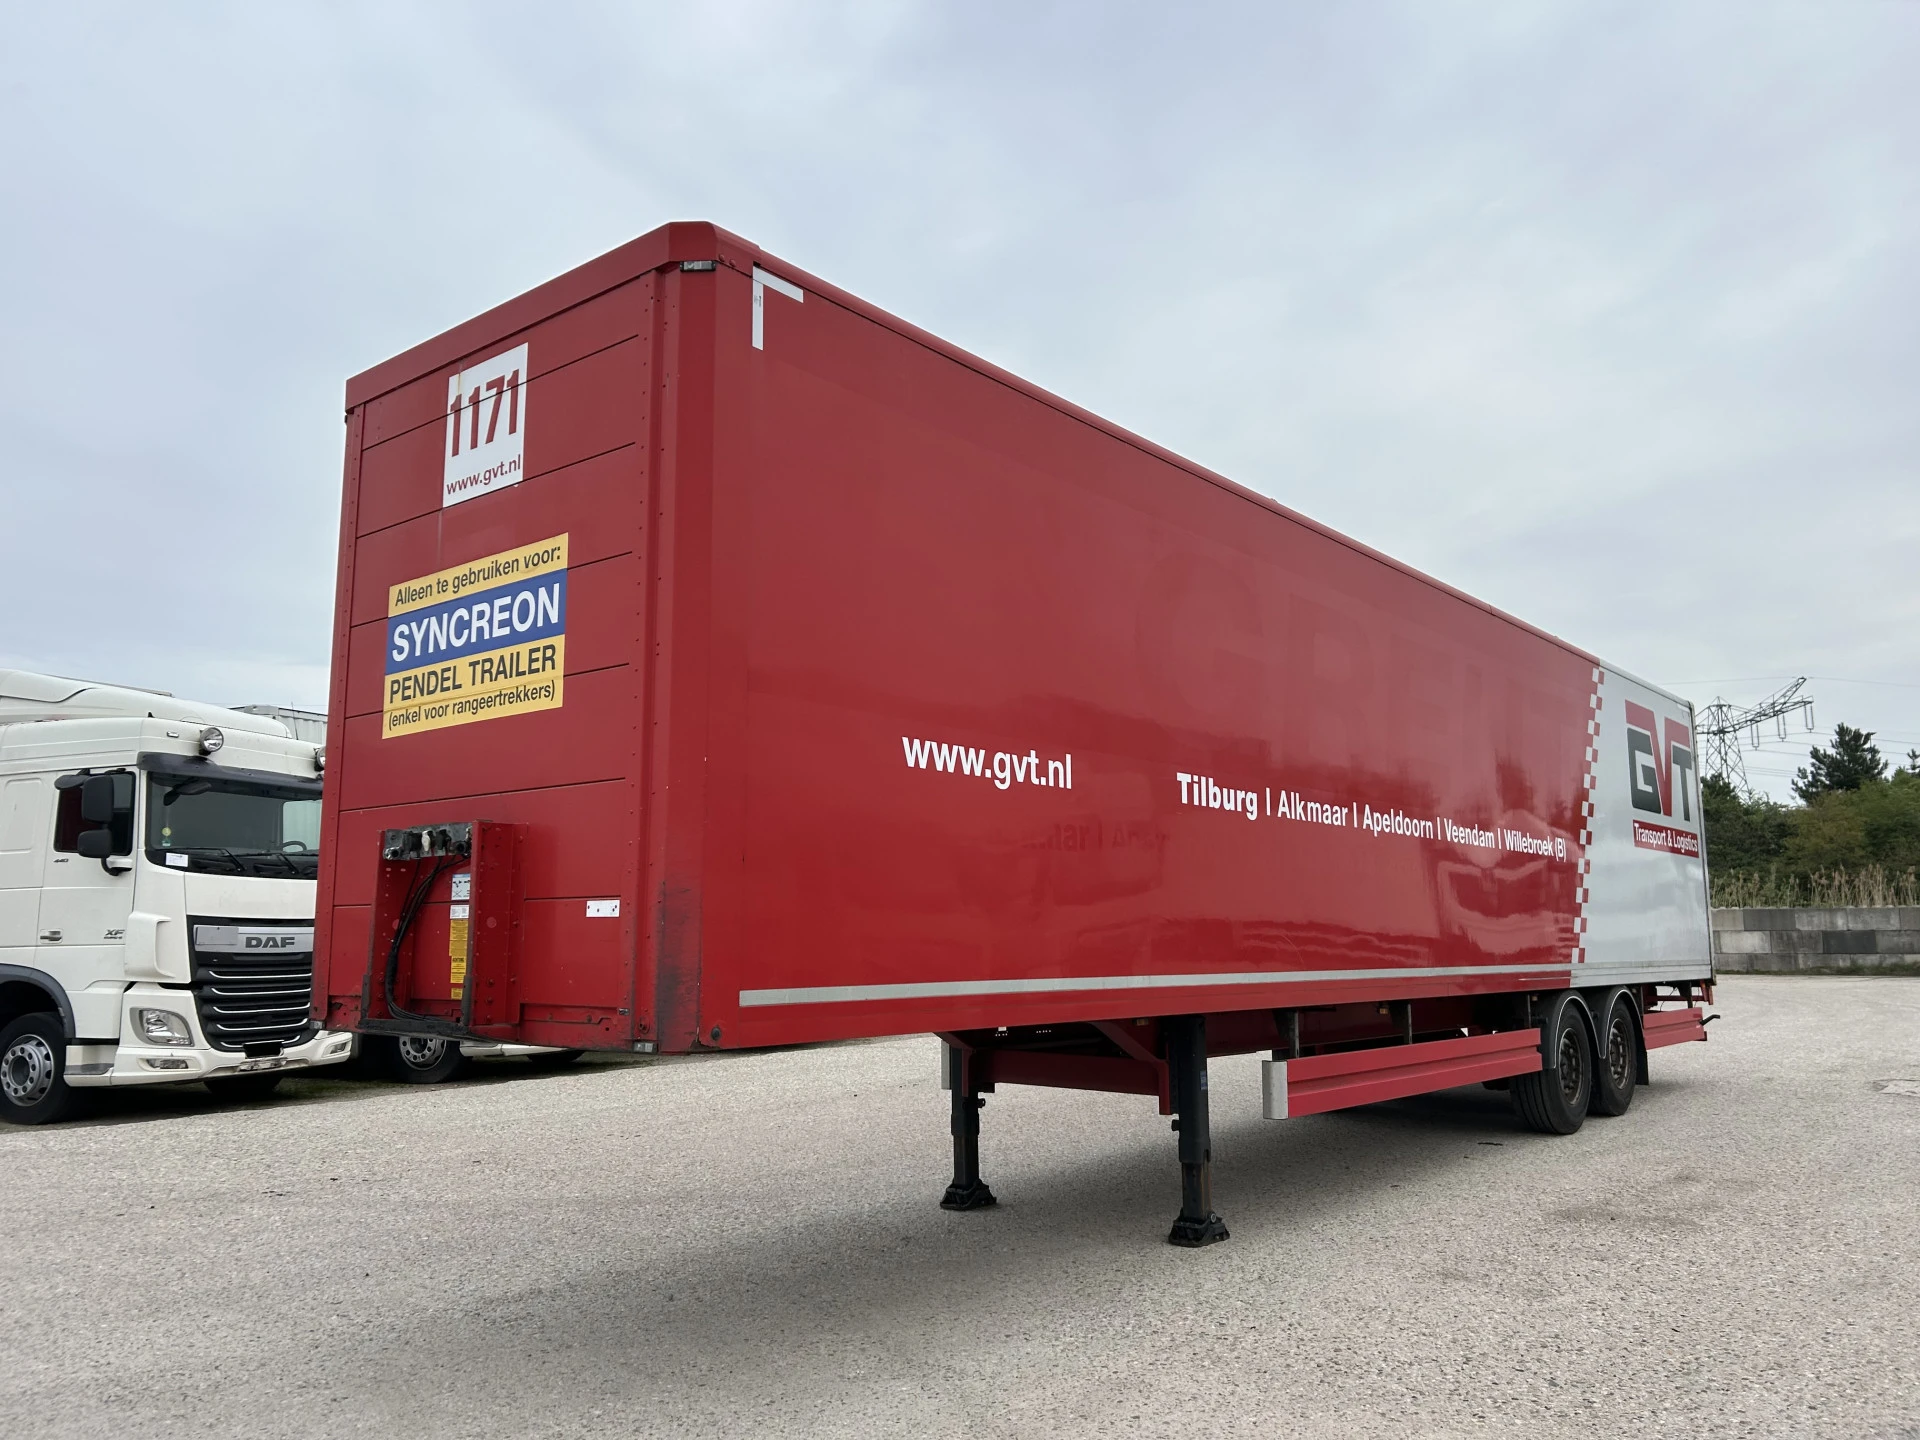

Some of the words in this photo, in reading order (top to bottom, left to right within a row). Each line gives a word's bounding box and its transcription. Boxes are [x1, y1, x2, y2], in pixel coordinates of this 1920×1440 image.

[450, 368, 520, 458] 1171
[446, 453, 521, 495] www.gvt.nl
[395, 585, 433, 607] Alleen
[436, 578, 449, 594] te
[452, 557, 520, 594] gebruiken
[523, 546, 561, 569] voor:
[392, 583, 560, 662] SYNCREON
[389, 665, 462, 704] PENDEL
[468, 643, 556, 687] TRAILER
[389, 706, 421, 731] (enkel
[424, 704, 450, 721] voor
[452, 680, 555, 715] rangeertrekkers)
[901, 736, 1073, 790] www.gvt.nl
[1625, 699, 1692, 822] GVT
[1176, 772, 1258, 821] Tilburg
[1277, 790, 1349, 827] Alkmaar
[1362, 804, 1434, 839] Apeldoorn
[1443, 817, 1496, 849] Veendam
[1503, 828, 1554, 857] Willebroek
[1554, 837, 1567, 863] (B)
[1634, 822, 1667, 848] Transport
[1667, 829, 1673, 848] &
[1673, 831, 1698, 853] Logistics
[245, 937, 296, 949] DAF
